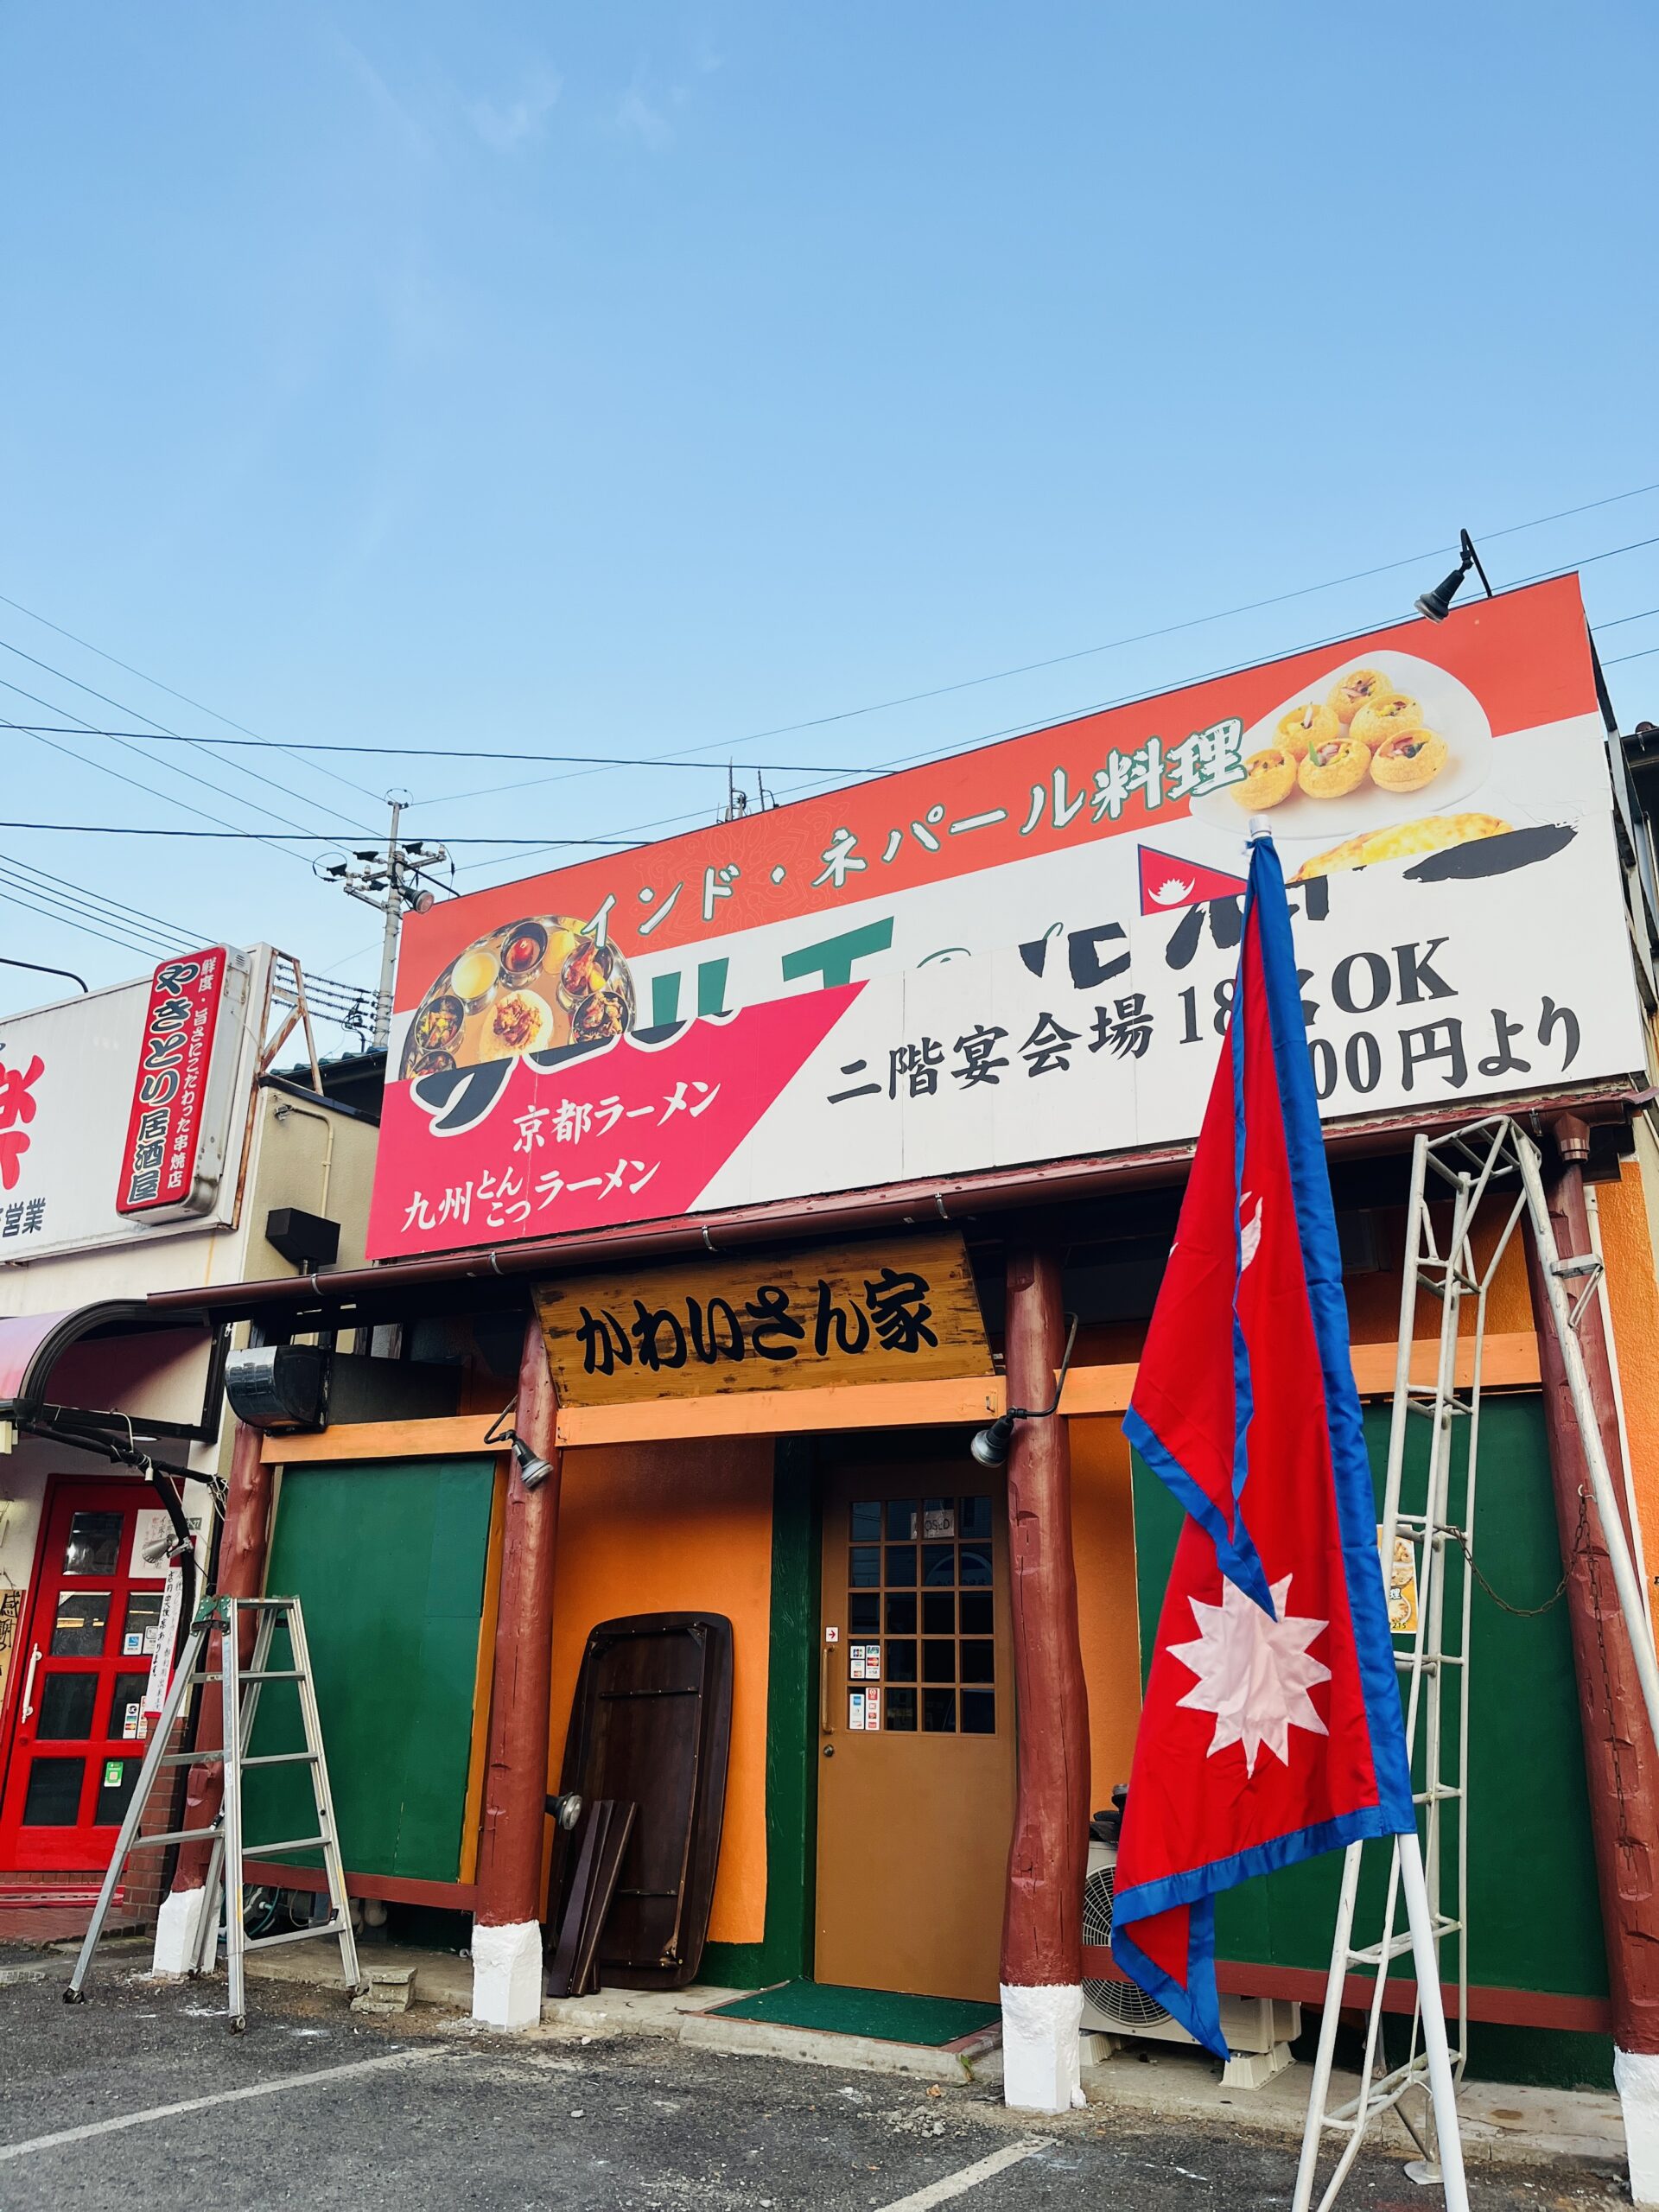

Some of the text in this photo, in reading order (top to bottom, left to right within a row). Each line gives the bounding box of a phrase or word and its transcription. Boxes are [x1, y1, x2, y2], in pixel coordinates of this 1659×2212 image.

[580, 716, 1248, 950] インド・ネパール料理
[128, 963, 200, 1205] やきとり居酒屋
[167, 957, 217, 1189] 鮮度・旨さにこだわった串焼店
[826, 992, 1155, 1105] 二階宴会場
[1306, 995, 1581, 1100] 00円より
[512, 1080, 721, 1154] 京都ラーメン
[0, 1198, 46, 1238] 営業
